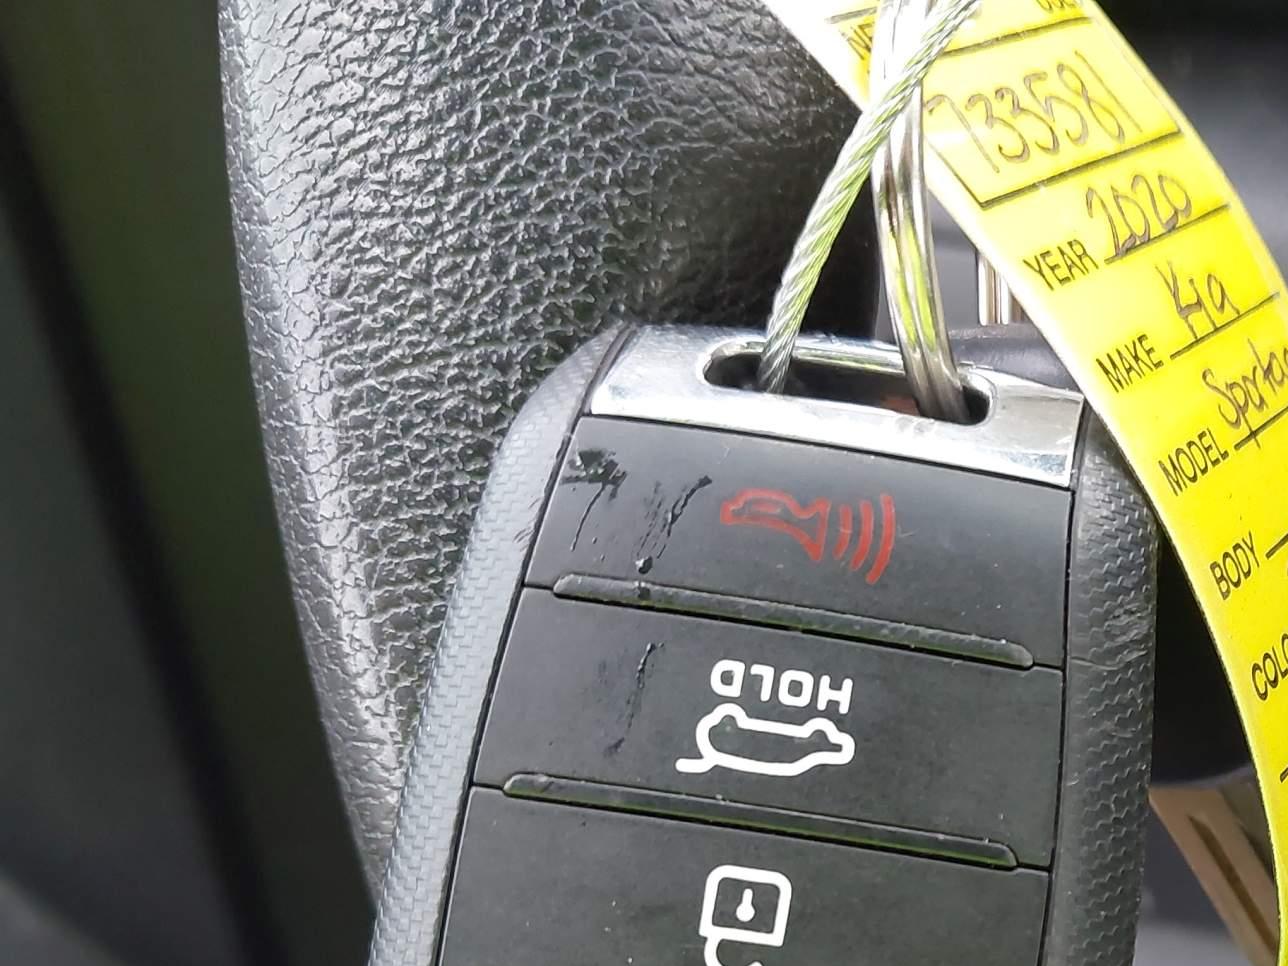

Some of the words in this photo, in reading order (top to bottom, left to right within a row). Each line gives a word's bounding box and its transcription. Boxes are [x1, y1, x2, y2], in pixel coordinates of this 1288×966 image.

[1023, 239, 1099, 291] YEAR
[1086, 174, 1192, 256] 2020
[1096, 334, 1164, 393] MAKE
[1158, 428, 1229, 496] MODEL
[1209, 531, 1260, 600] BODY
[710, 659, 853, 714] HOLD
